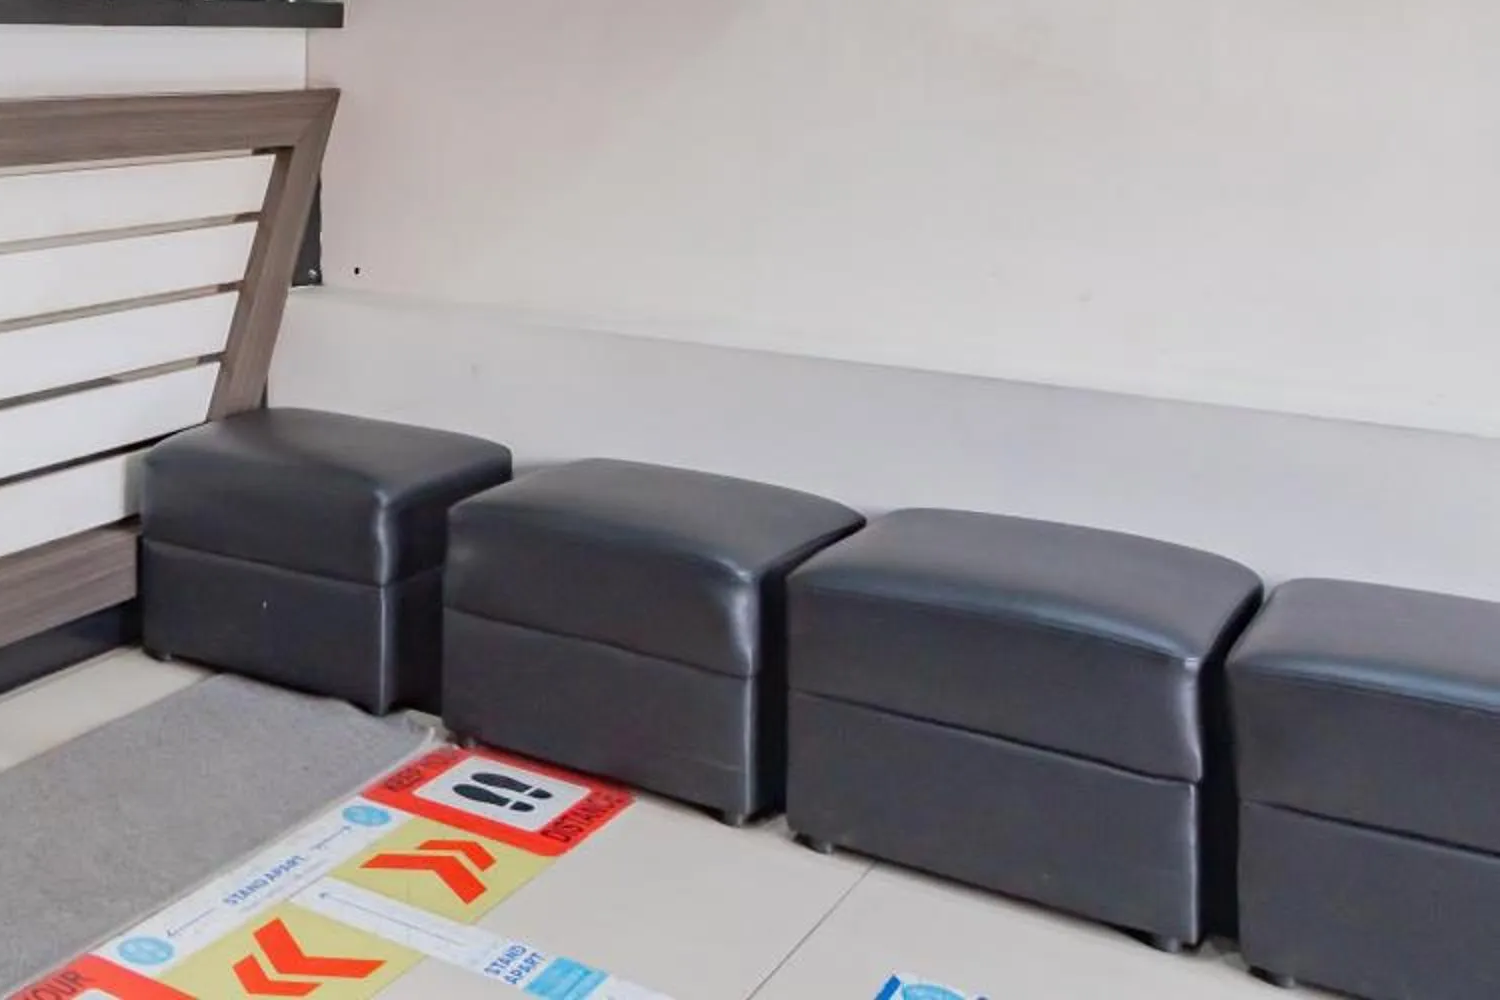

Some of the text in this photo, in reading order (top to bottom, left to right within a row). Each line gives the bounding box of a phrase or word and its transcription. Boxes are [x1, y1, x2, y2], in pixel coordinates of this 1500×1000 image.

[541, 790, 630, 843] DISTANCE
[484, 944, 527, 976] STAND
[21, 971, 97, 1000] OUR
